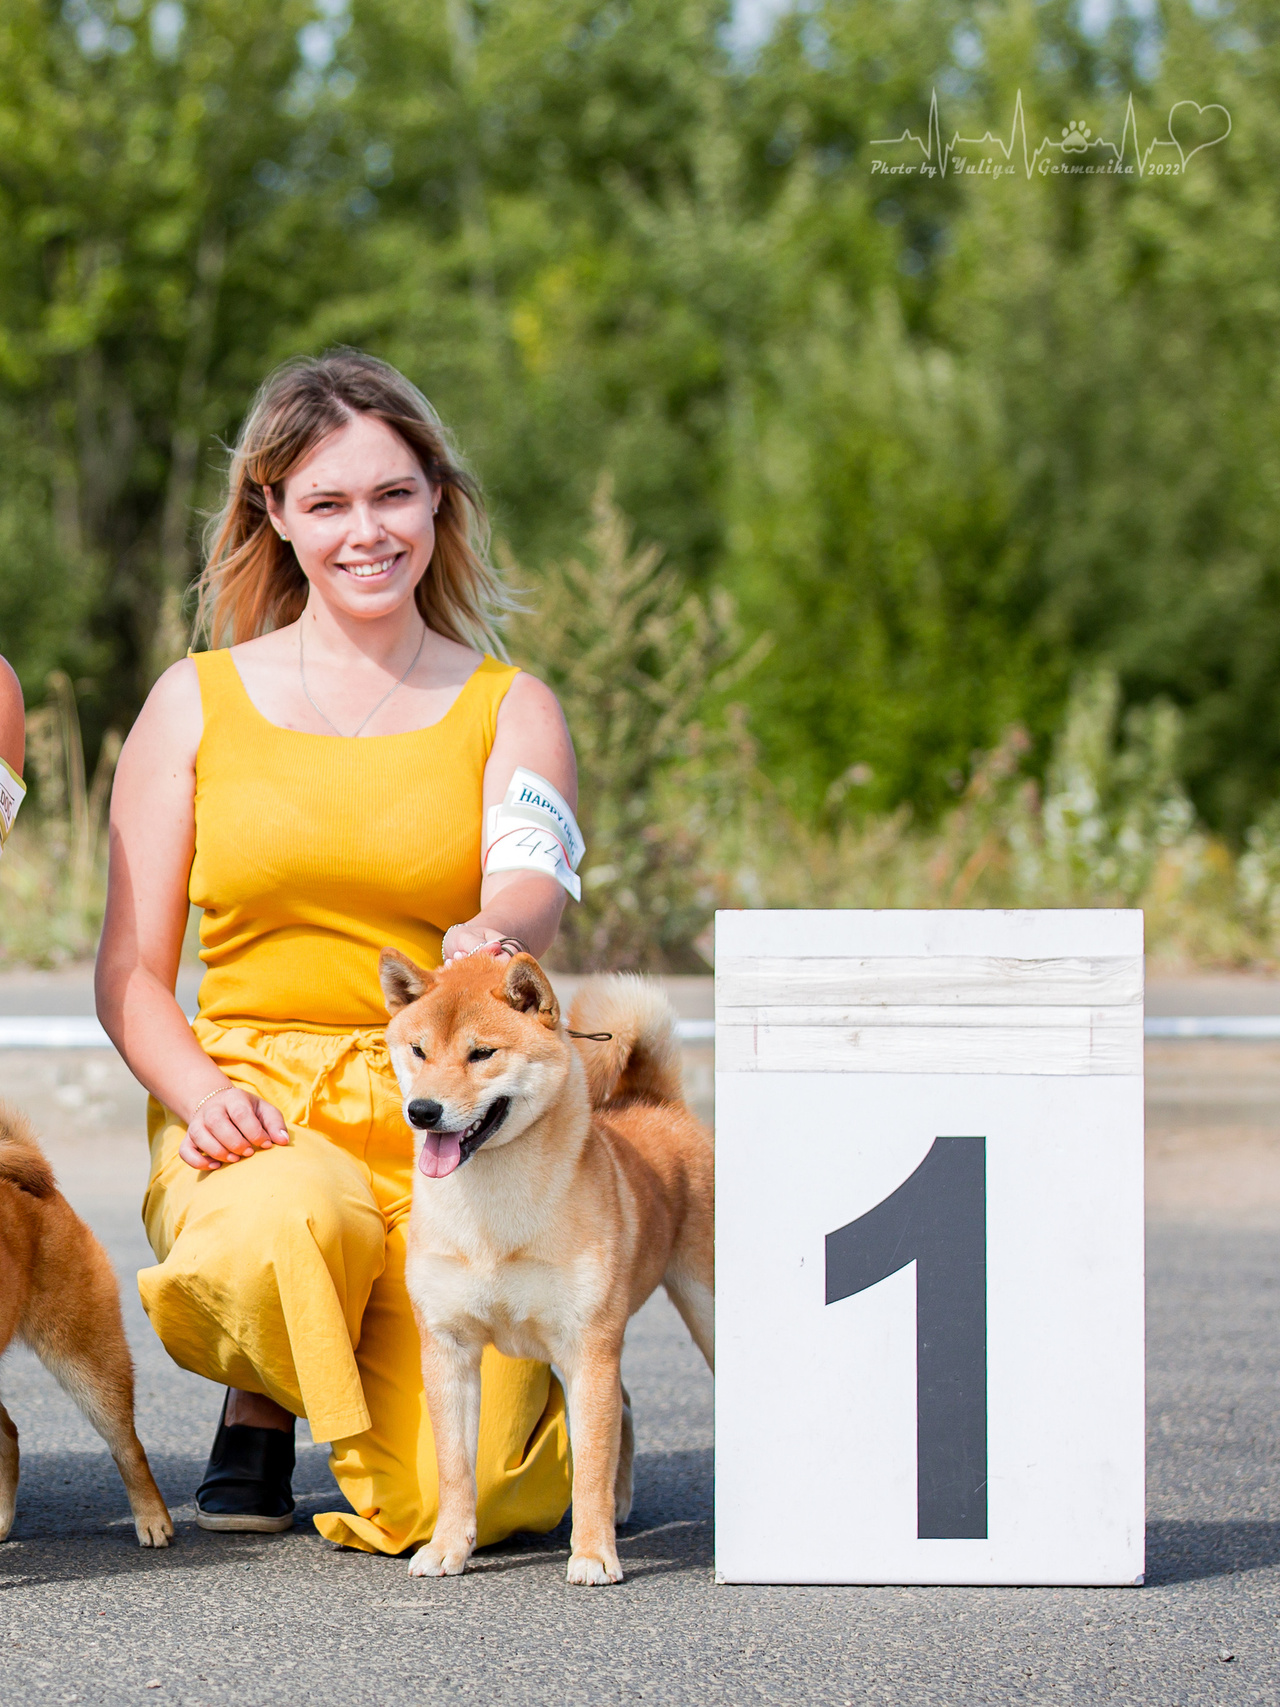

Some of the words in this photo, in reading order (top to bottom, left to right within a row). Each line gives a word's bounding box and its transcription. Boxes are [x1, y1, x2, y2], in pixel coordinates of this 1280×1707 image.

[519, 787, 564, 822] HAPPY
[516, 829, 562, 867] 44
[825, 1136, 988, 1539] 1
